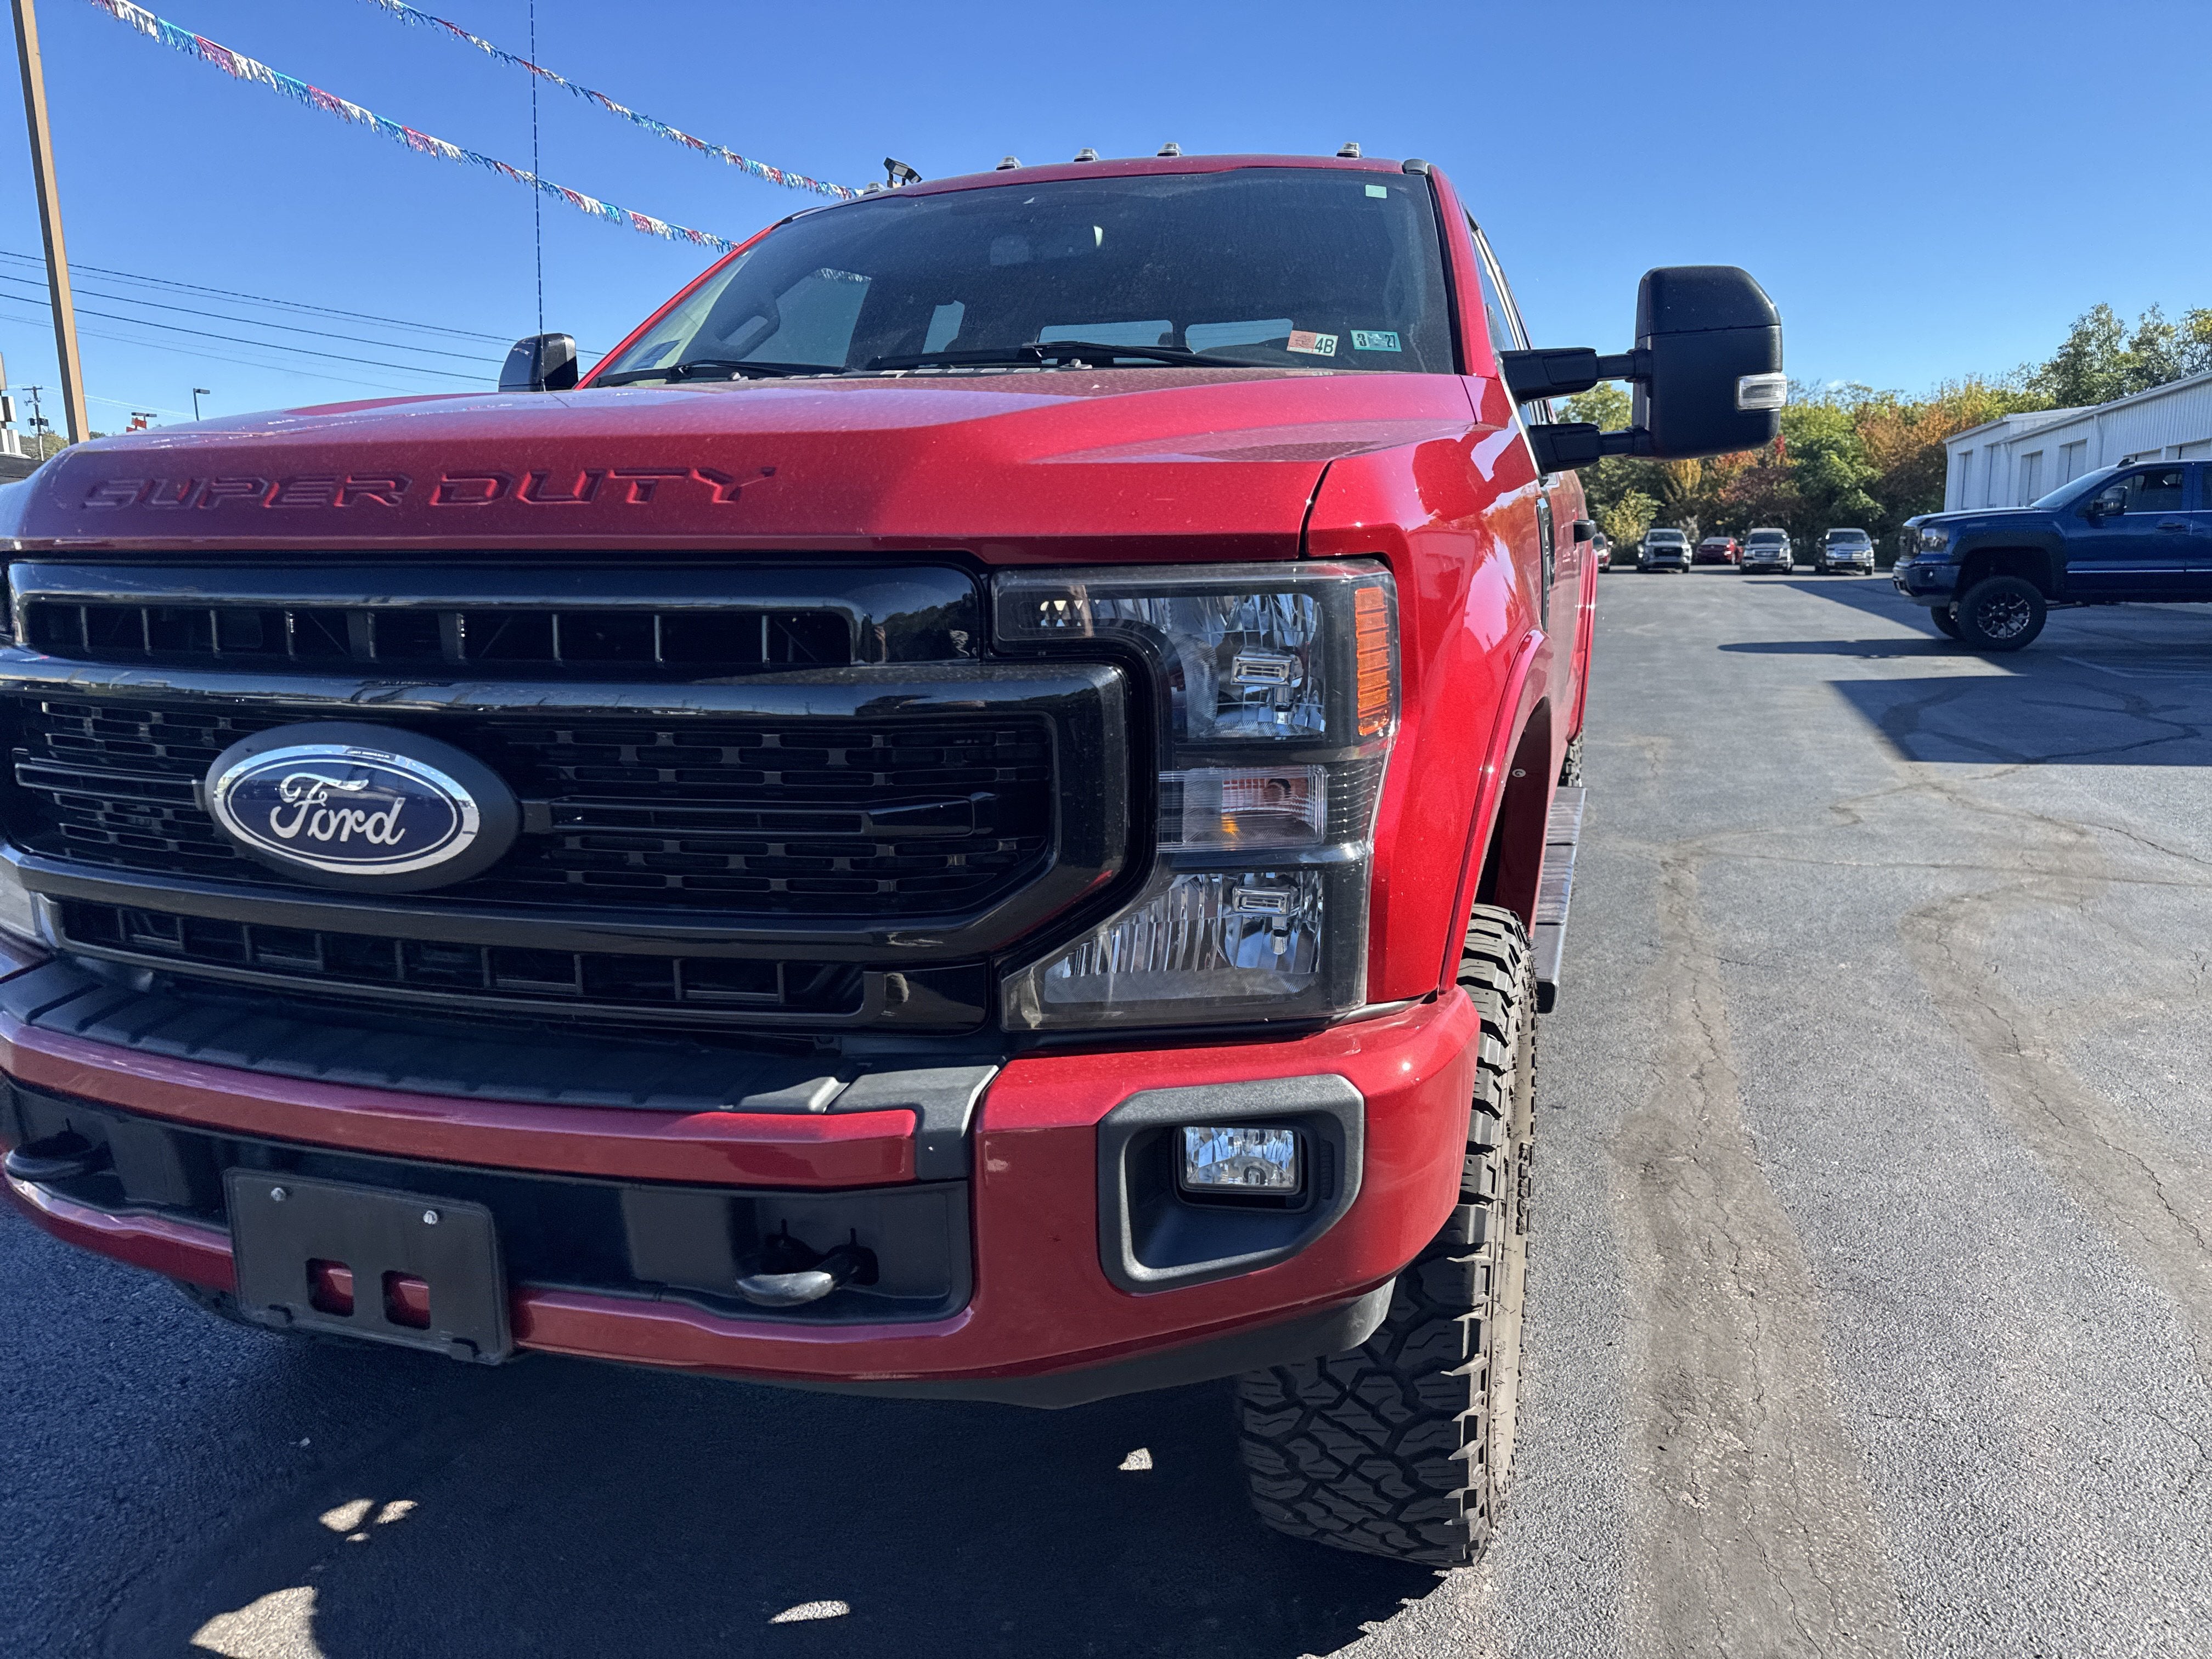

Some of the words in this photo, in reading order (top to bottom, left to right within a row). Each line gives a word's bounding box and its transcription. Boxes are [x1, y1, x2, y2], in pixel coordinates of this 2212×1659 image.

[1314, 337, 1334, 354] 4B
[1356, 333, 1367, 347] 3
[1385, 334, 1396, 348] 27
[81, 474, 413, 509] SUPER
[430, 467, 776, 506] DUTY
[270, 772, 406, 845] Ford
